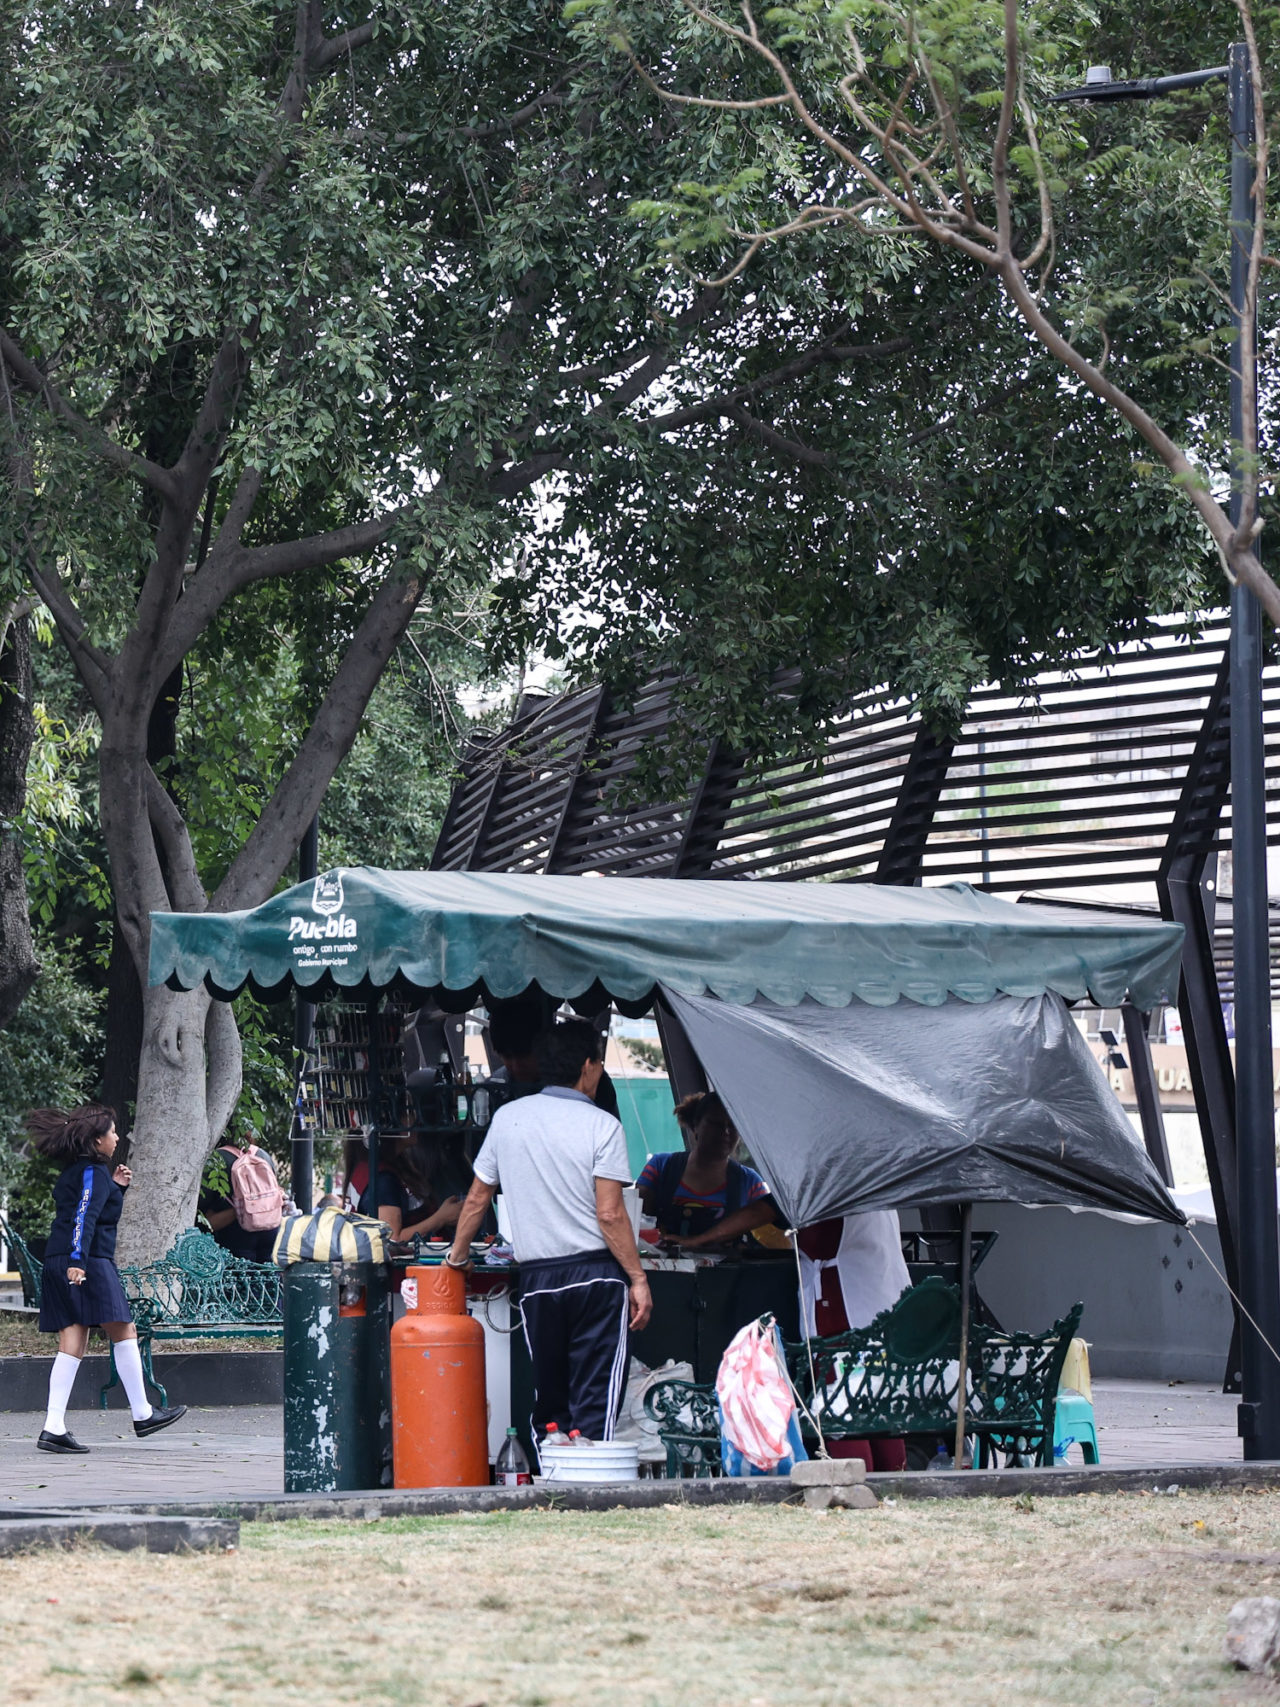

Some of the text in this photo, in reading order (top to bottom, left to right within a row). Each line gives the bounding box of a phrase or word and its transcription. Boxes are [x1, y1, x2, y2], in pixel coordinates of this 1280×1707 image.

[293, 944, 316, 956] ontigo
[320, 945, 333, 953] con
[333, 942, 358, 952] rumbo
[298, 958, 322, 967] Gobierno
